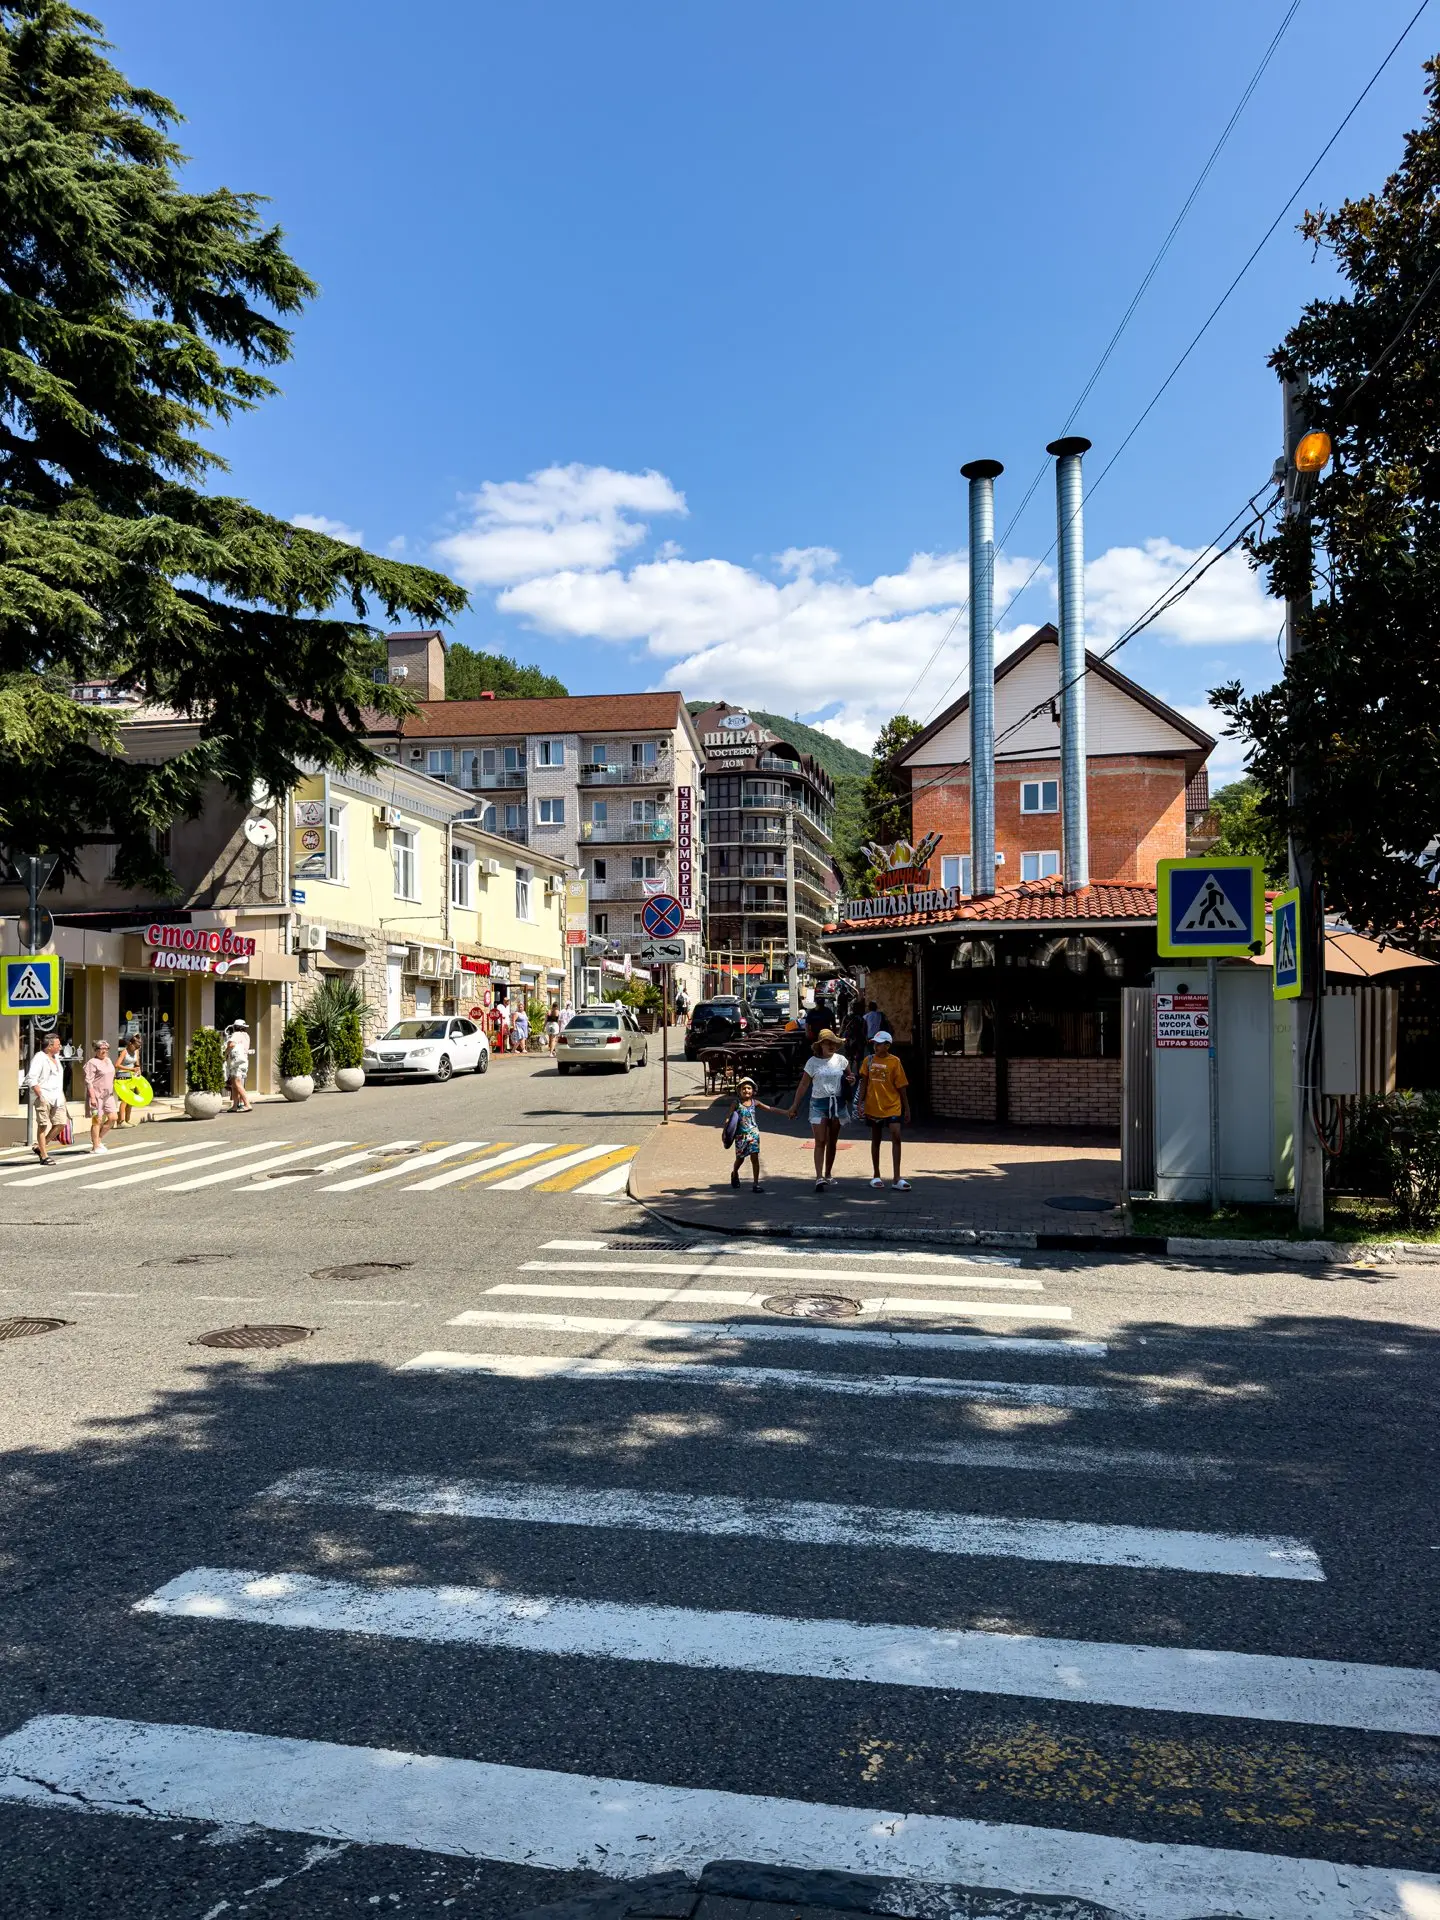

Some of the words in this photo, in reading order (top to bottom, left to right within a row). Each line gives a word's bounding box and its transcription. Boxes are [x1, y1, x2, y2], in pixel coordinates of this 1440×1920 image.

[704, 729, 773, 746] ШИРАК
[709, 745, 758, 757] ГОСТЕВОЙ
[721, 760, 744, 768] ДОМ
[679, 788, 690, 908] ЧЕРНОМОРЕЦ
[875, 868, 930, 891] ОТЛИЧНАЯ
[849, 888, 959, 919] ШАШЛЫЧНАЯ
[147, 924, 256, 956] столовая
